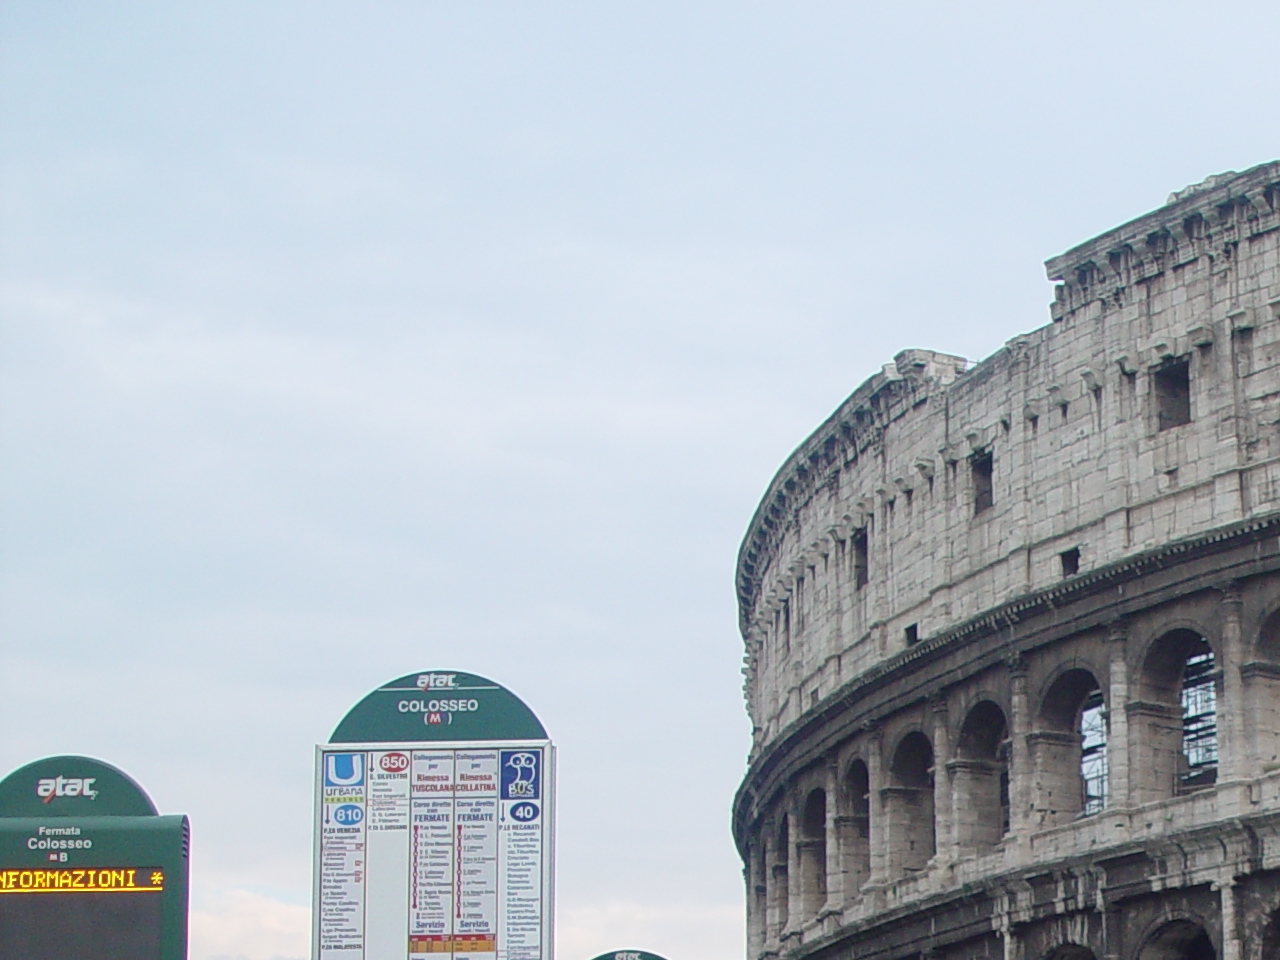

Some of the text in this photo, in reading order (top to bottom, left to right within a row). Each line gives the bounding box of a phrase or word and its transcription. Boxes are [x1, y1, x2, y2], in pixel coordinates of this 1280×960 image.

[398, 698, 479, 713] COLOSSEO
[381, 756, 408, 769] 850
[460, 773, 492, 781] Rimessa
[38, 776, 98, 801] atac
[508, 781, 535, 795] BUS
[336, 808, 362, 822] 810
[414, 814, 450, 822] FERMATE
[457, 813, 493, 821] FERMATE
[515, 806, 534, 819] 40
[38, 826, 81, 836] Fermata
[27, 837, 93, 850] Colosseo
[416, 920, 445, 928] Servizio
[460, 920, 489, 928] Servizio
